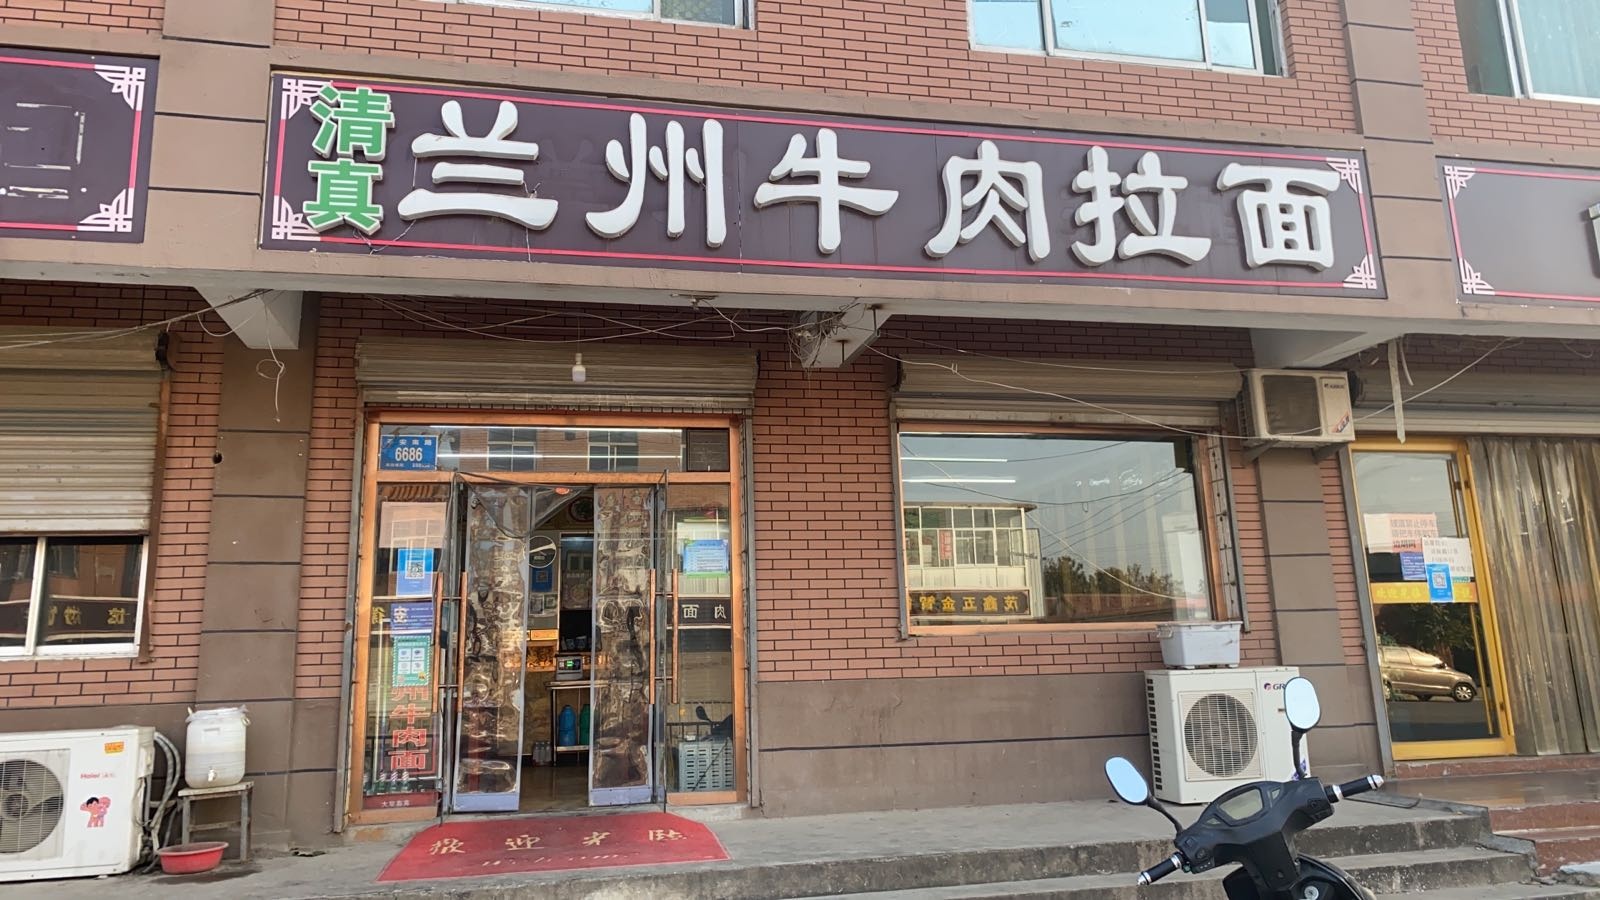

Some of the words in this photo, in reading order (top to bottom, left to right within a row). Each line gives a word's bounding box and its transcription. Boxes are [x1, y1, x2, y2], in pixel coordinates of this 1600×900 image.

[302, 82, 396, 236] 清真
[397, 99, 1342, 272] 兰州牛肉拉面
[395, 447, 423, 462] 6686
